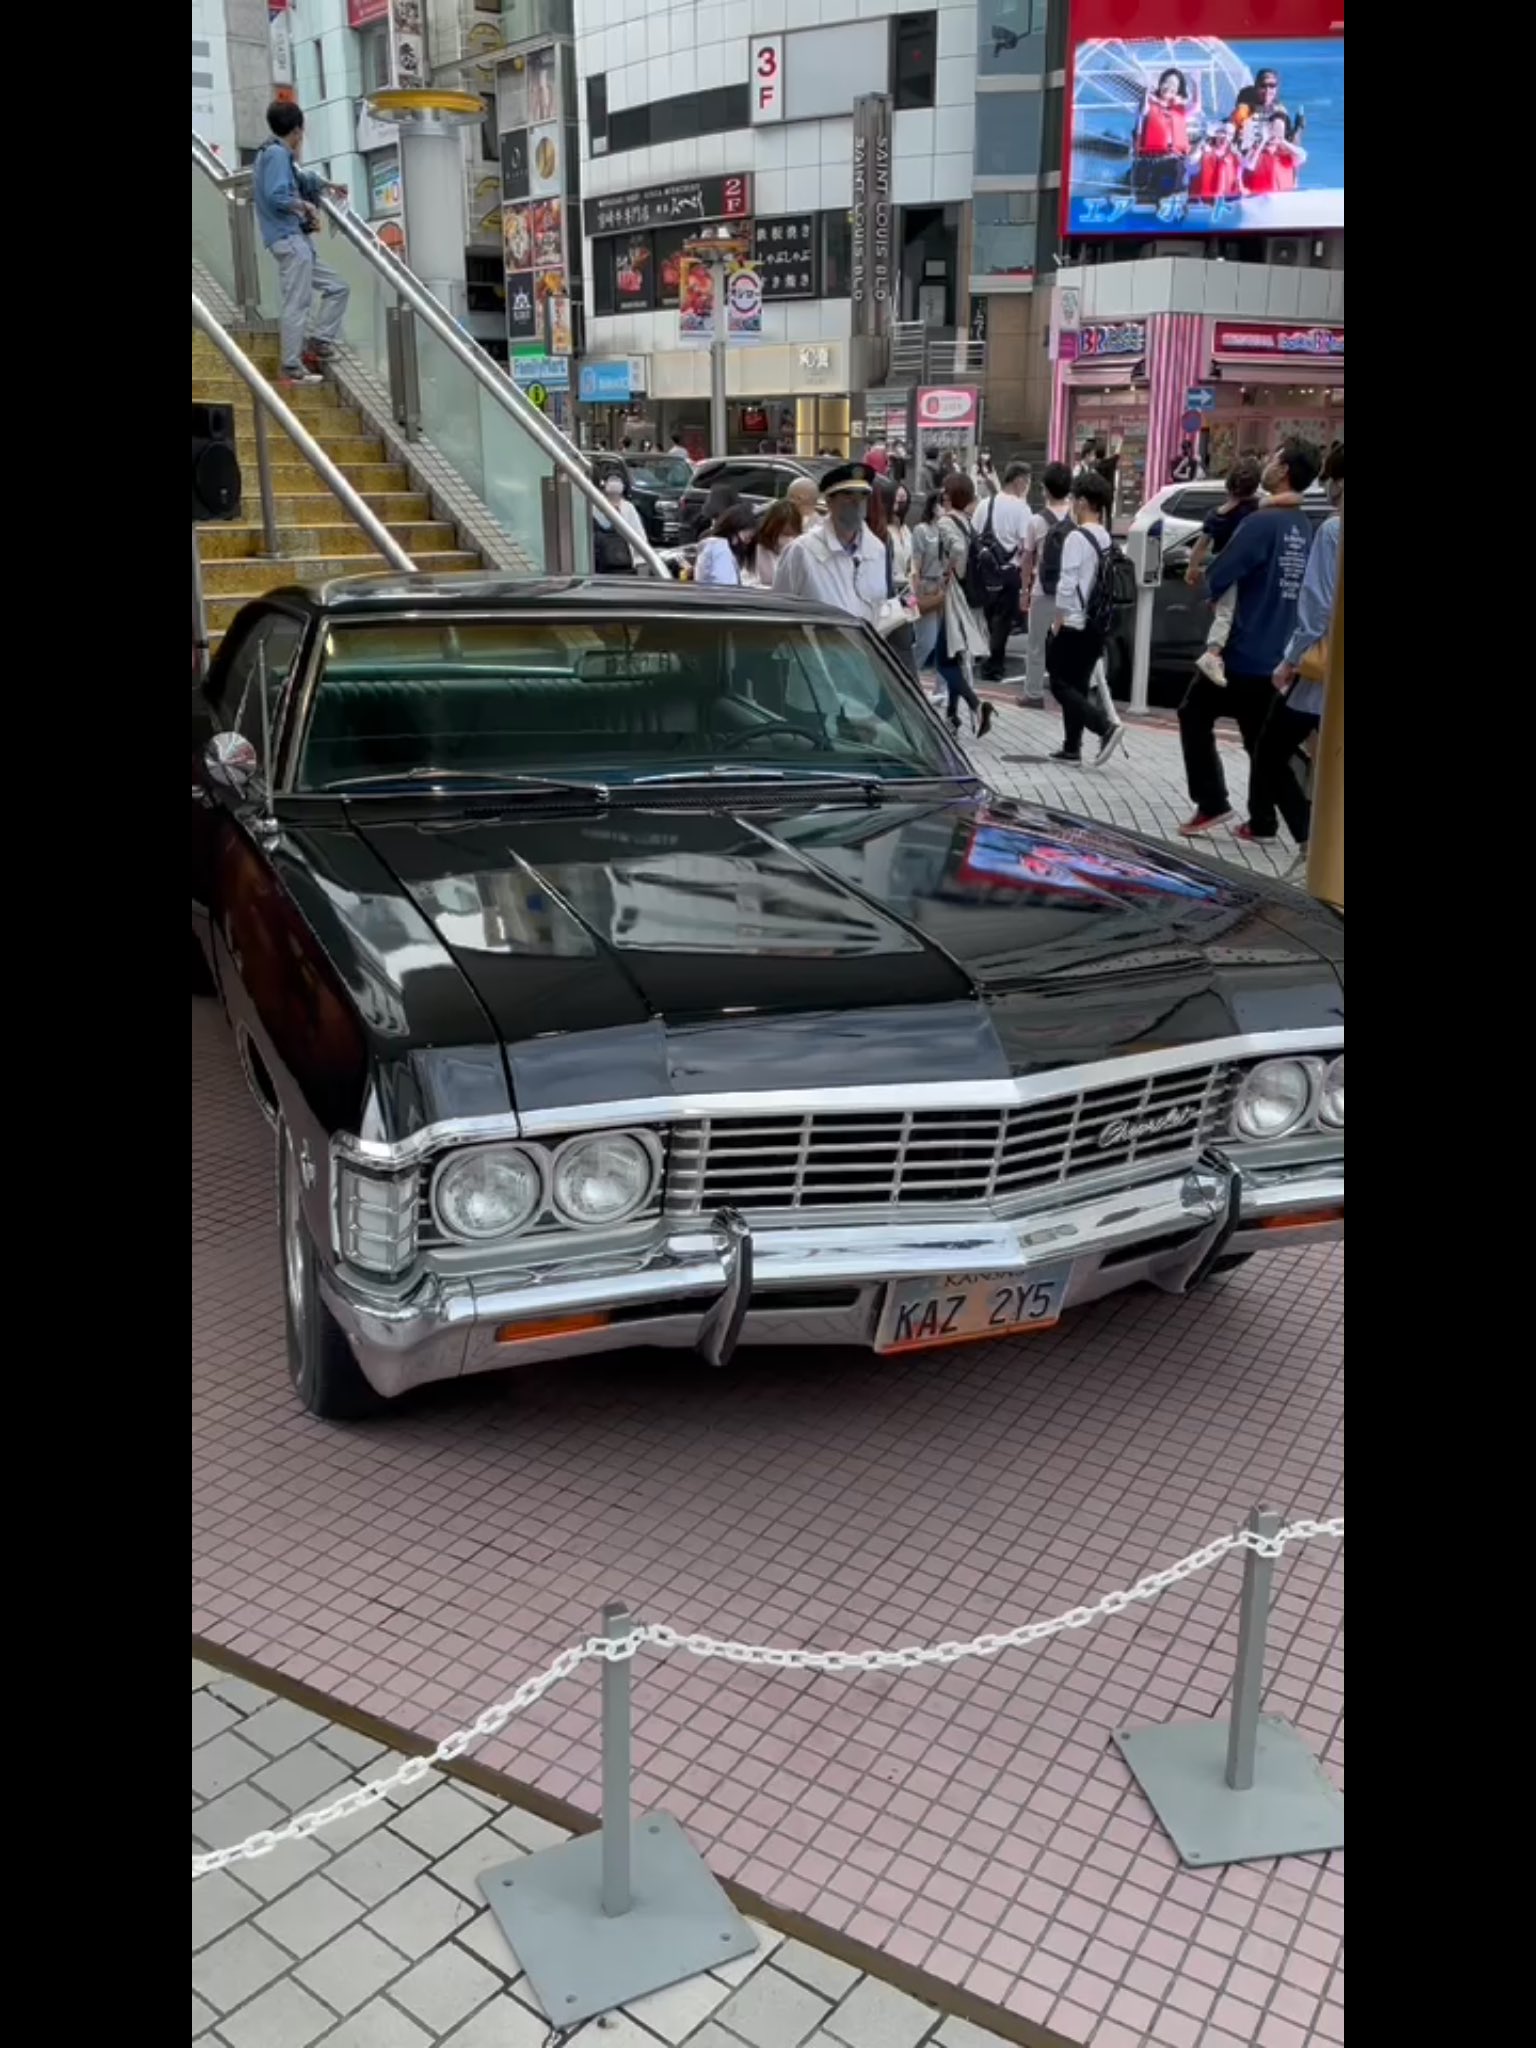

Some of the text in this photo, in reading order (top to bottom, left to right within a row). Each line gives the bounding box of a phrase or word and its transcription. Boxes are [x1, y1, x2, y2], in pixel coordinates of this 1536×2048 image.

[876, 136, 889, 194] SAINT
[876, 202, 889, 257] LOUIS
[894, 1282, 1055, 1342] KAZ 2Y5
